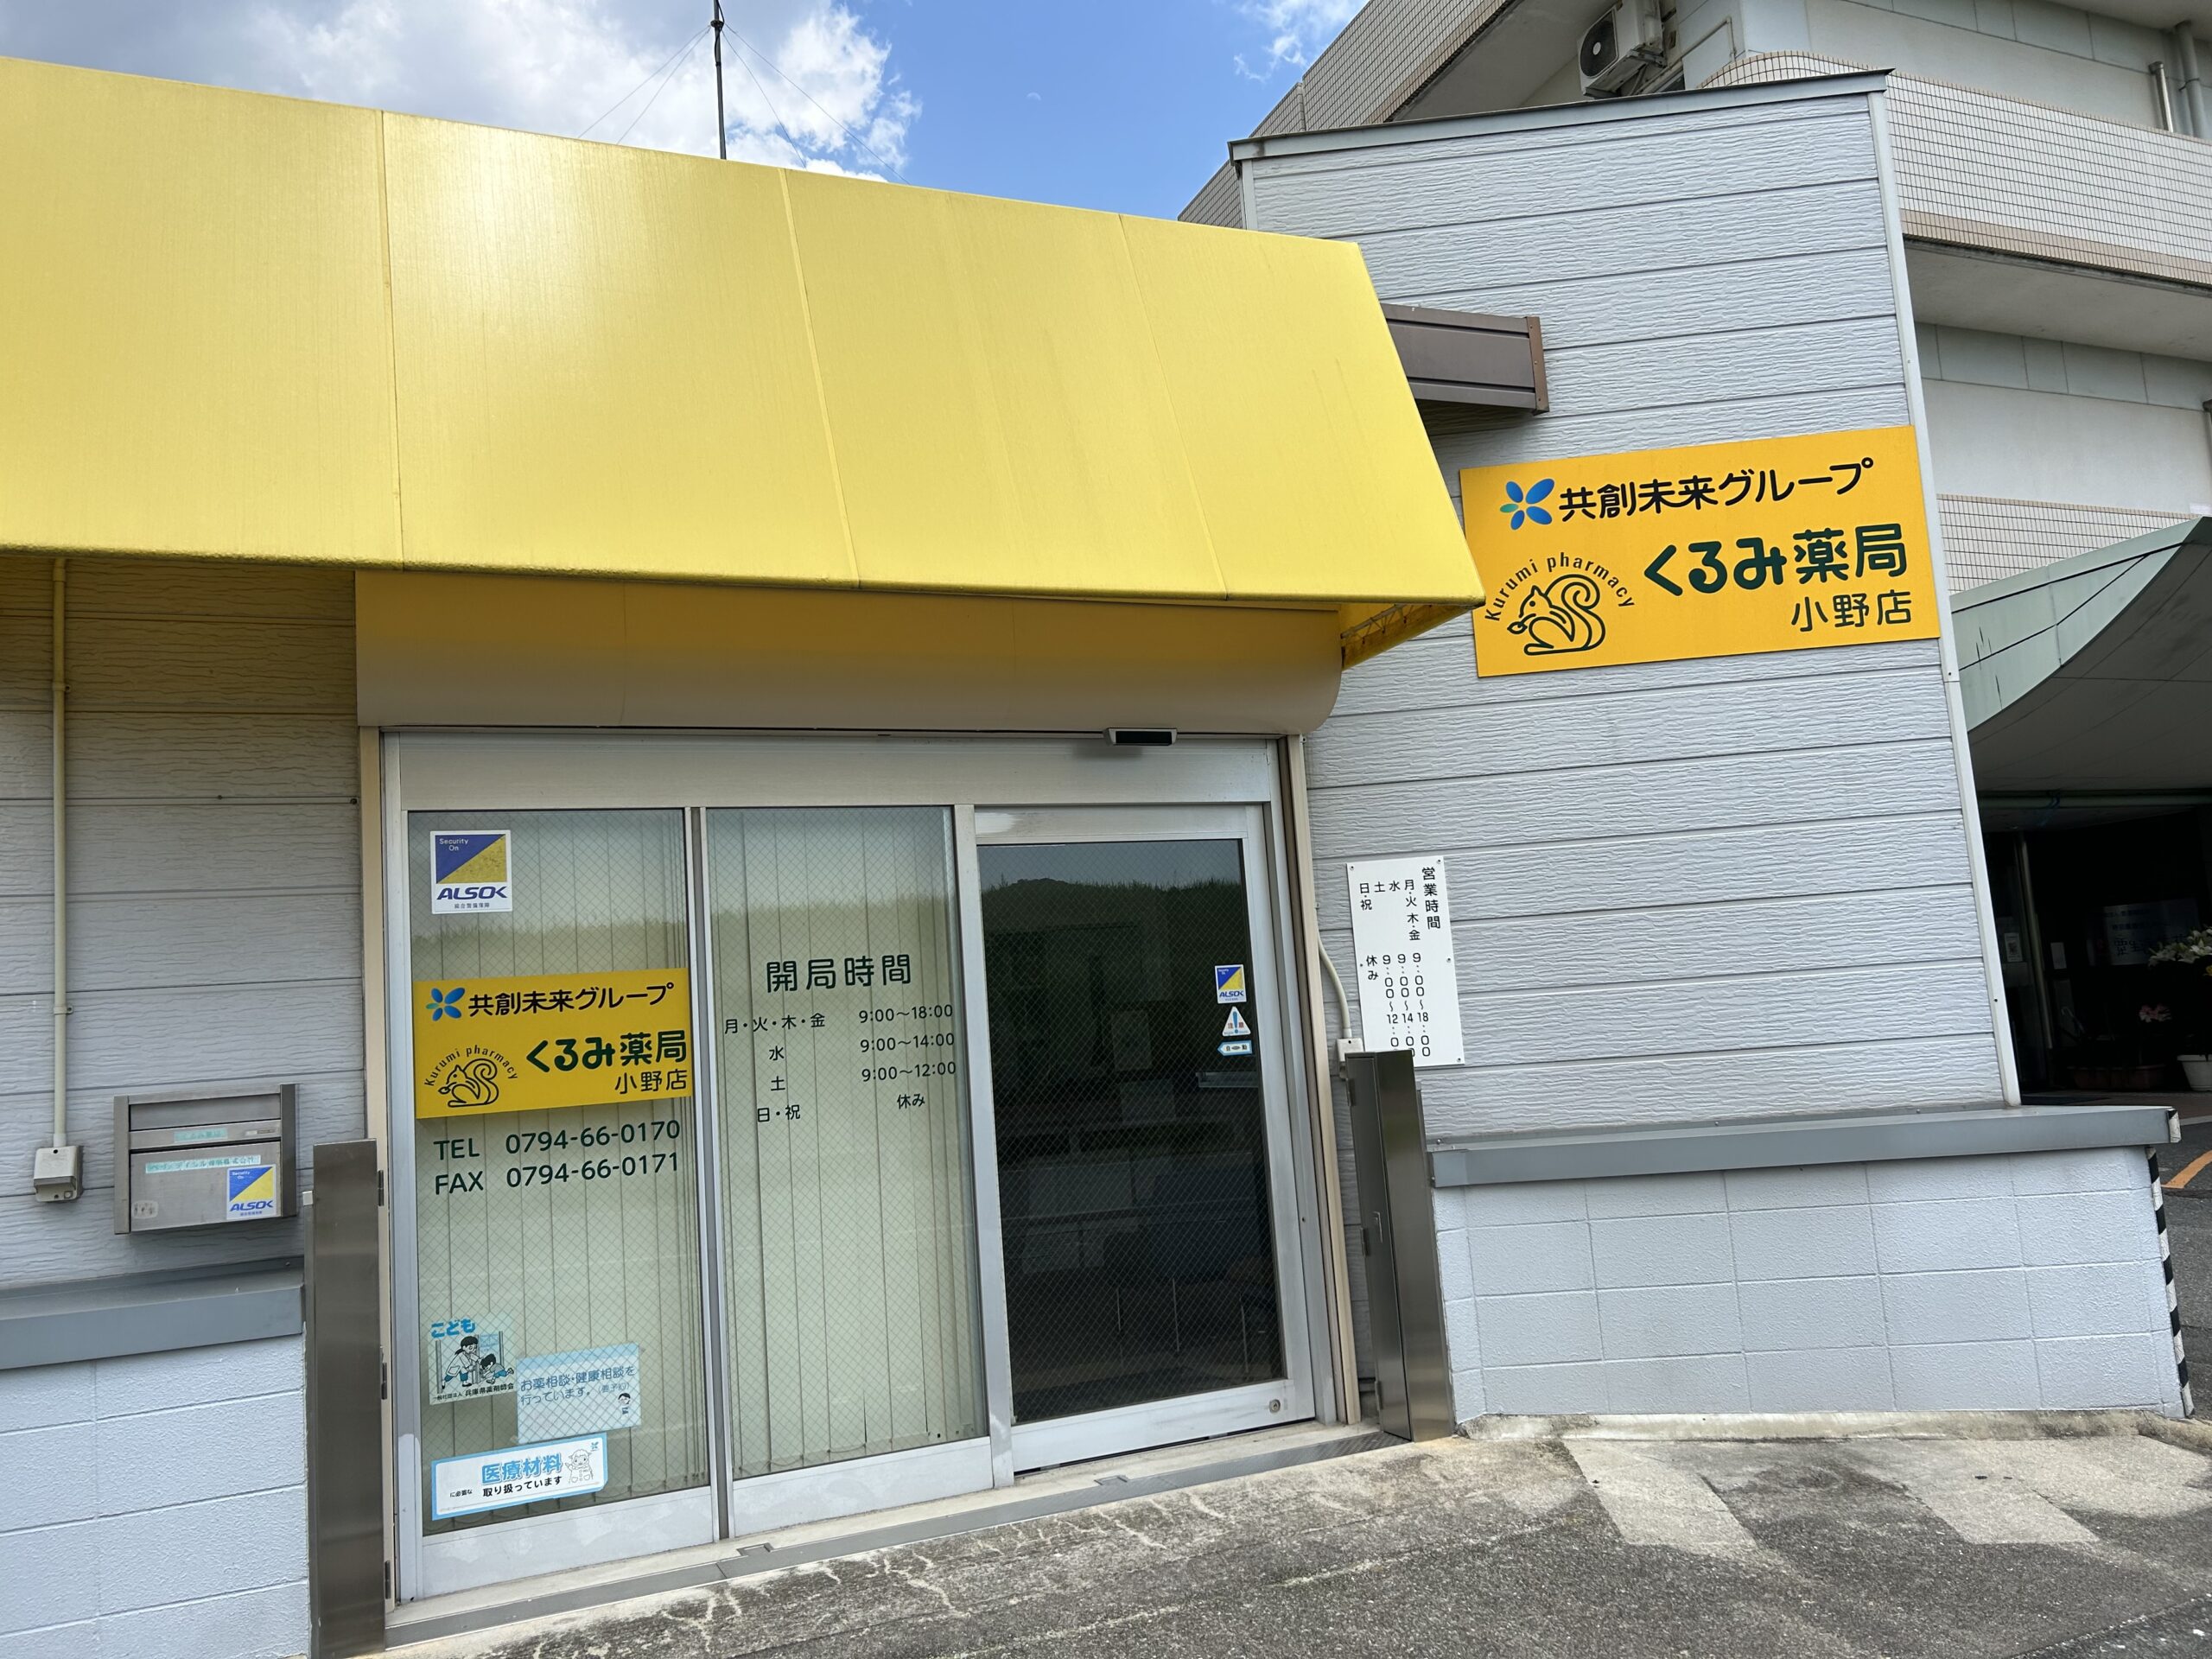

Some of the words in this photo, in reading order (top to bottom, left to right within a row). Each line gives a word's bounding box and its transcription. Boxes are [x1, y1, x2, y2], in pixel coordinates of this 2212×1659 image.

[1558, 456, 1874, 523] 共創未来グループ
[1643, 522, 1908, 596] くるみ薬局
[1484, 560, 1540, 623] Kurumi
[1547, 551, 1636, 609] pharmacy
[1790, 589, 1913, 632] 小野店
[436, 886, 508, 900] ALSOK
[1359, 882, 1372, 911] 日・祝
[1374, 881, 1386, 893] 土
[1388, 880, 1401, 892] 水
[1421, 866, 1441, 930] 営業時間
[766, 954, 912, 993] 開局時間
[1365, 955, 1379, 981] 休み
[467, 982, 674, 1017] 共創未来グループ
[724, 1013, 826, 1034] 月・火・木・金
[423, 1047, 461, 1087] Kurumi
[466, 1044, 518, 1080] pharmacy
[525, 1029, 688, 1073] くるみ薬局
[768, 1046, 785, 1061] 水
[614, 1068, 688, 1095] 小野店
[770, 1076, 786, 1091] 土
[757, 1104, 801, 1122] 日・祝
[896, 1093, 926, 1109] 休み
[433, 1138, 480, 1160] TEL
[505, 1120, 681, 1154] 0794-66-0170
[435, 1171, 484, 1195] FAX
[506, 1152, 678, 1188] 0794-66-0171
[230, 1199, 274, 1212] ALSOK
[430, 1318, 476, 1338] こども
[520, 1365, 636, 1392] お薬相談・健康相談を
[481, 1453, 563, 1484] 医療材料
[449, 1489, 474, 1498] に必要な
[482, 1475, 563, 1497] 取り扱っています
